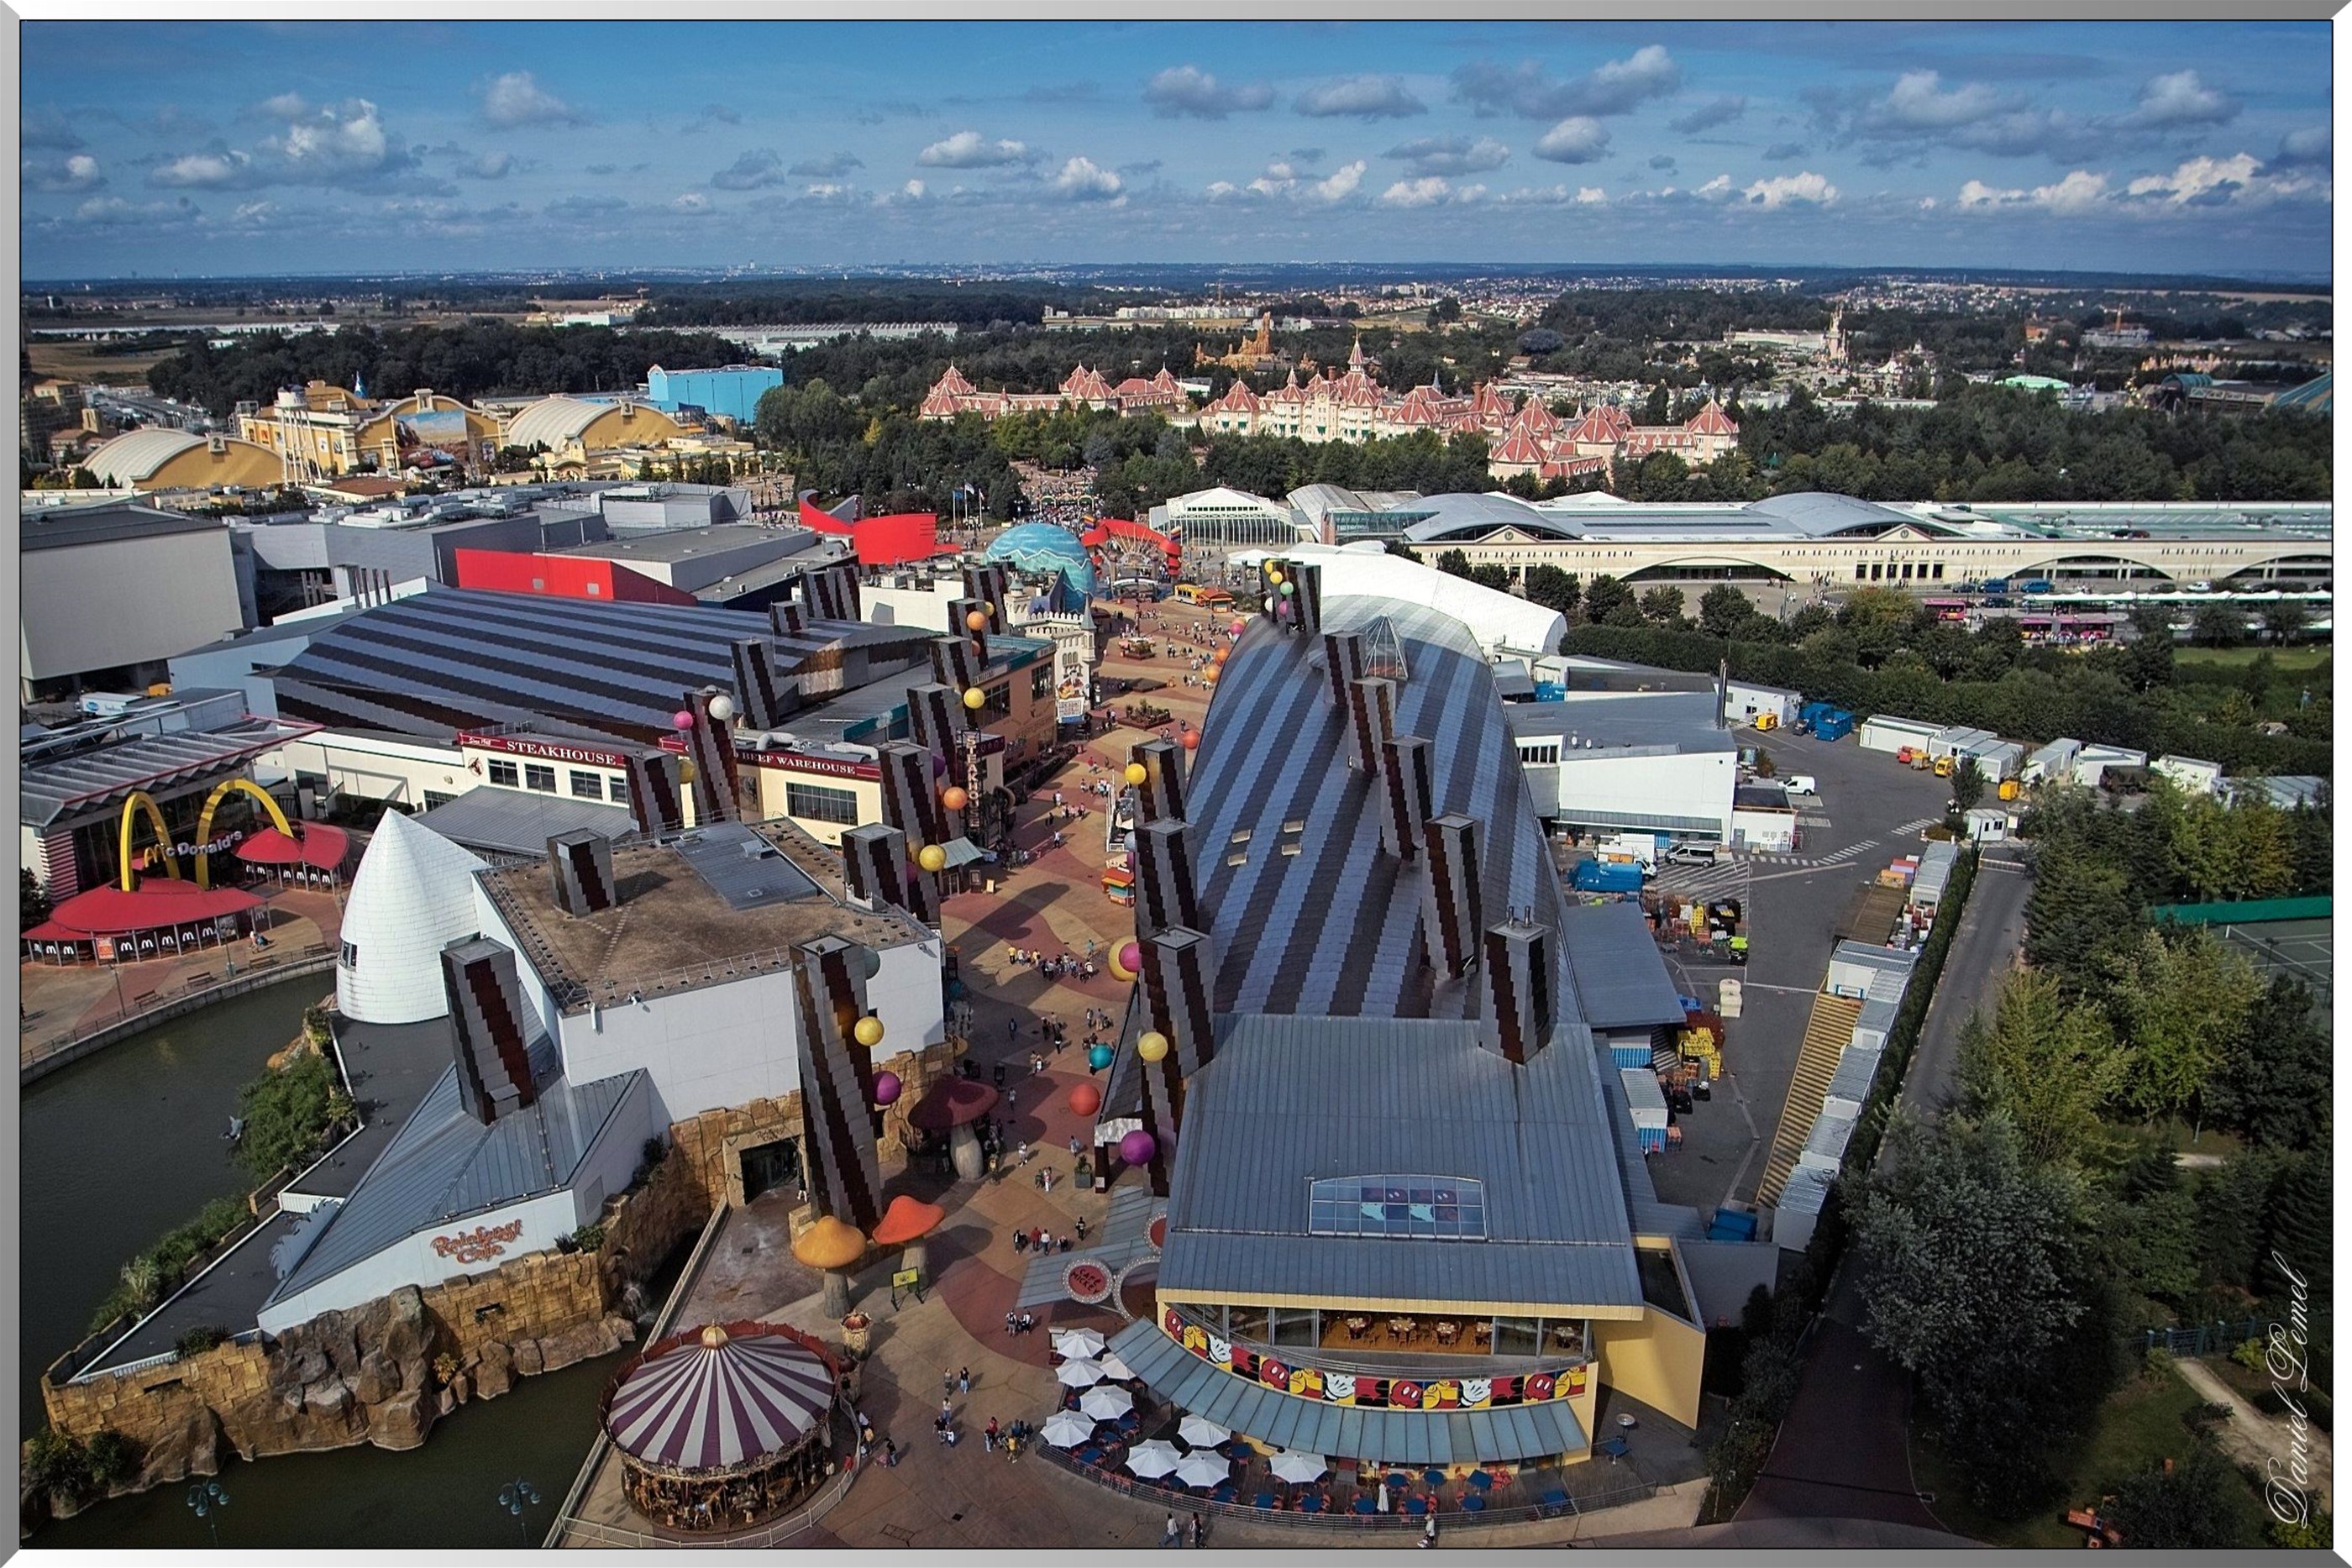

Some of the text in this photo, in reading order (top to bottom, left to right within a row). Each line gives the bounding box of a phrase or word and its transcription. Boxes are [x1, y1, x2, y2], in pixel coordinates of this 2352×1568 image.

[625, 403, 630, 413] 3
[213, 438, 221, 449] 2
[507, 741, 617, 766] STEAKHOUSE
[743, 752, 855, 774] BEEF WAREHOUSE
[967, 737, 980, 827] STEAKHOUSE
[1070, 1272, 1100, 1294] MICKEY
